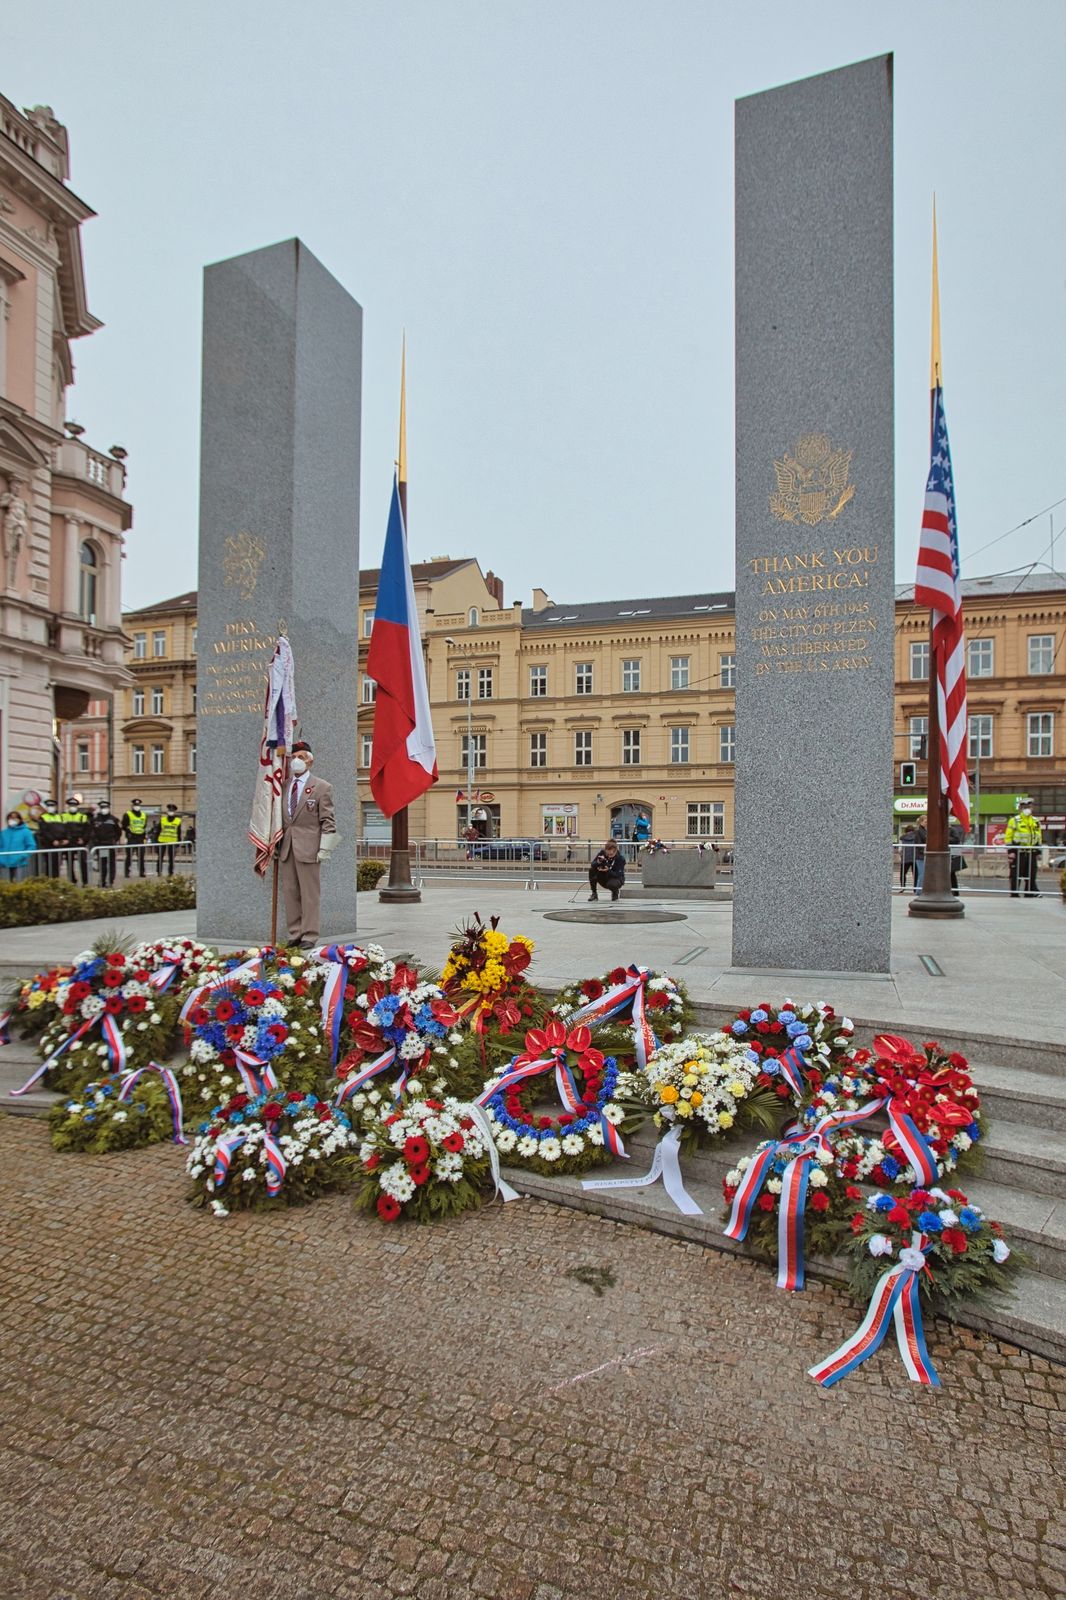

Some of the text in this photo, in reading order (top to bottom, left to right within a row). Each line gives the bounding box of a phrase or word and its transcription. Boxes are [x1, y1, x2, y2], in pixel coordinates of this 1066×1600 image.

[750, 544, 878, 574] THANK YOU
[761, 571, 869, 595] AMERICA!
[759, 601, 869, 622] ON MAY 6TH 1945
[751, 627, 777, 641] THE
[780, 624, 811, 639] CITY
[813, 623, 830, 636] OF
[761, 638, 867, 657] WAS LIBERATED
